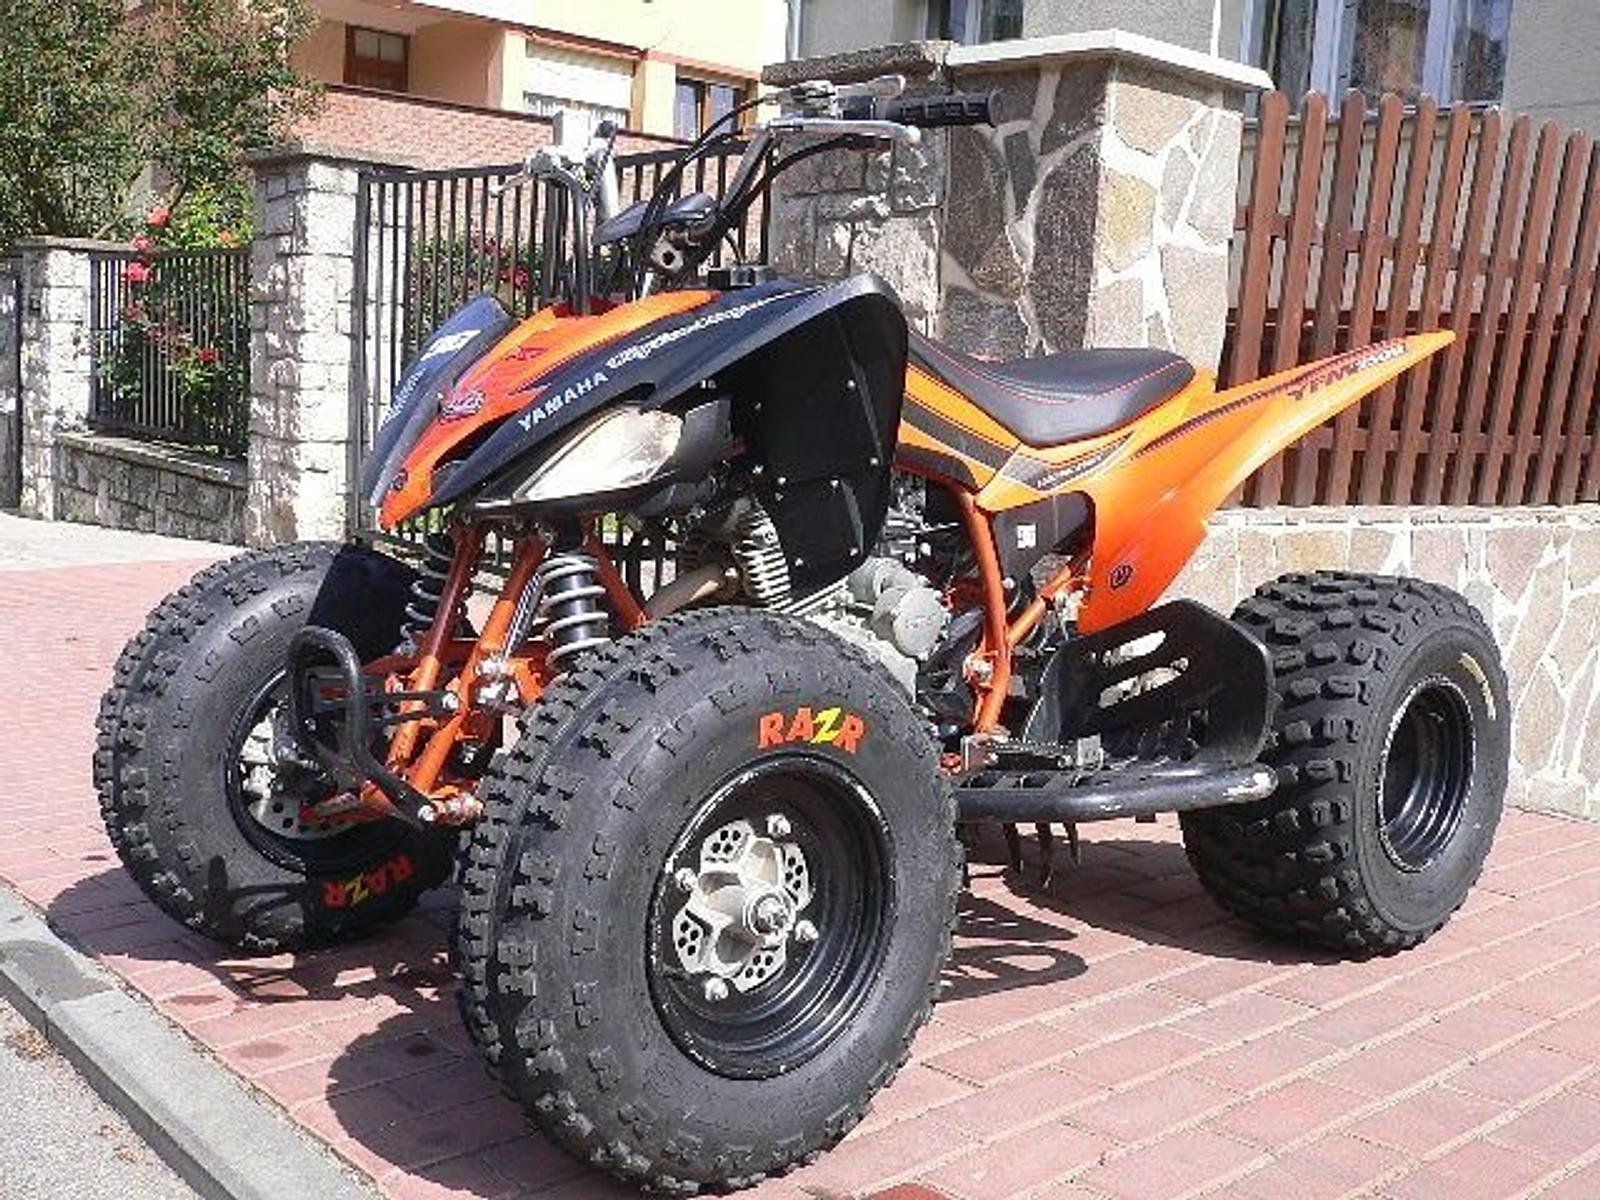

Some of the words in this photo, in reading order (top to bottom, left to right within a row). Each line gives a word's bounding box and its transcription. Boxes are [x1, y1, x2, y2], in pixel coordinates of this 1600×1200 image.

[517, 372, 608, 432] YAMAHA
[757, 706, 866, 754] RAZR
[322, 856, 413, 909] RAZR
